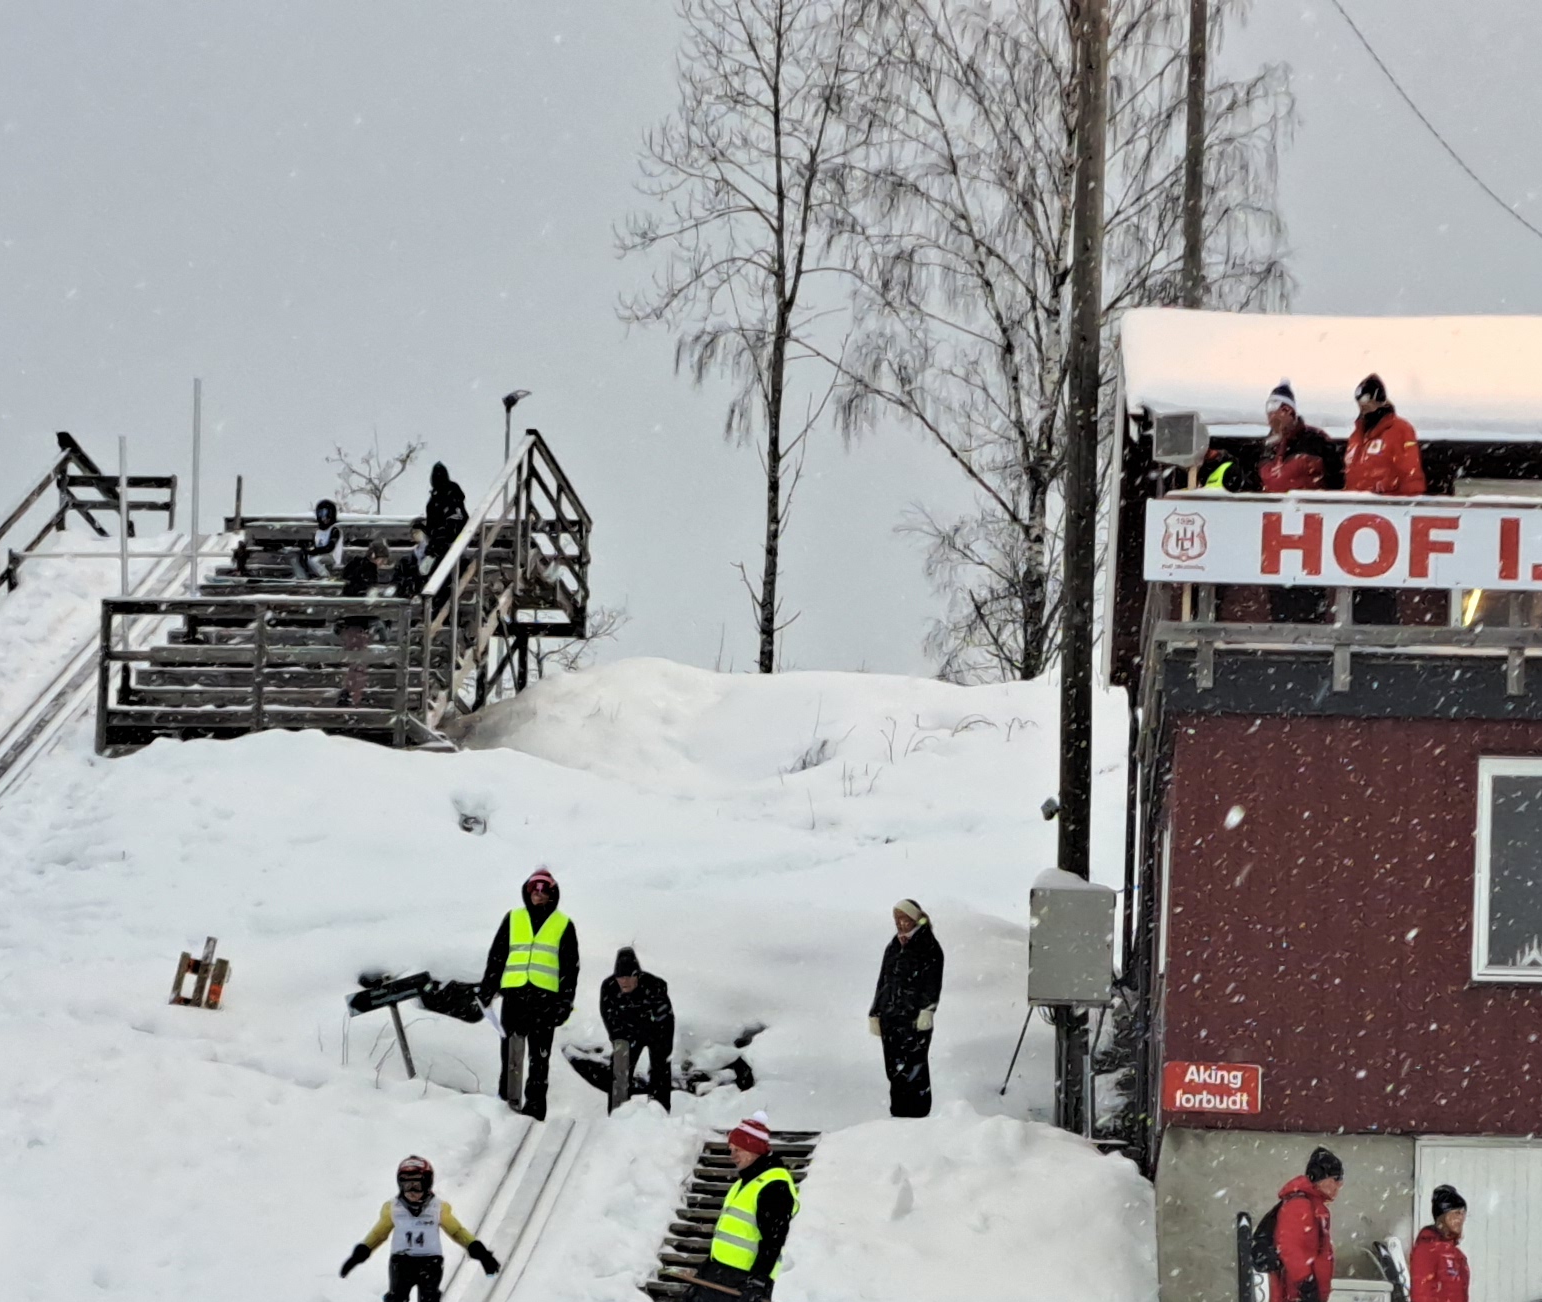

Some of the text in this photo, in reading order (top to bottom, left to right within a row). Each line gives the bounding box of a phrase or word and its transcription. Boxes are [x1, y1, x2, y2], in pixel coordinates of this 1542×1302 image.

[1260, 511, 1460, 579] HOF
[1184, 1064, 1244, 1089] Aking
[1175, 1088, 1250, 1111] forbudt
[405, 1230, 425, 1248] 14
